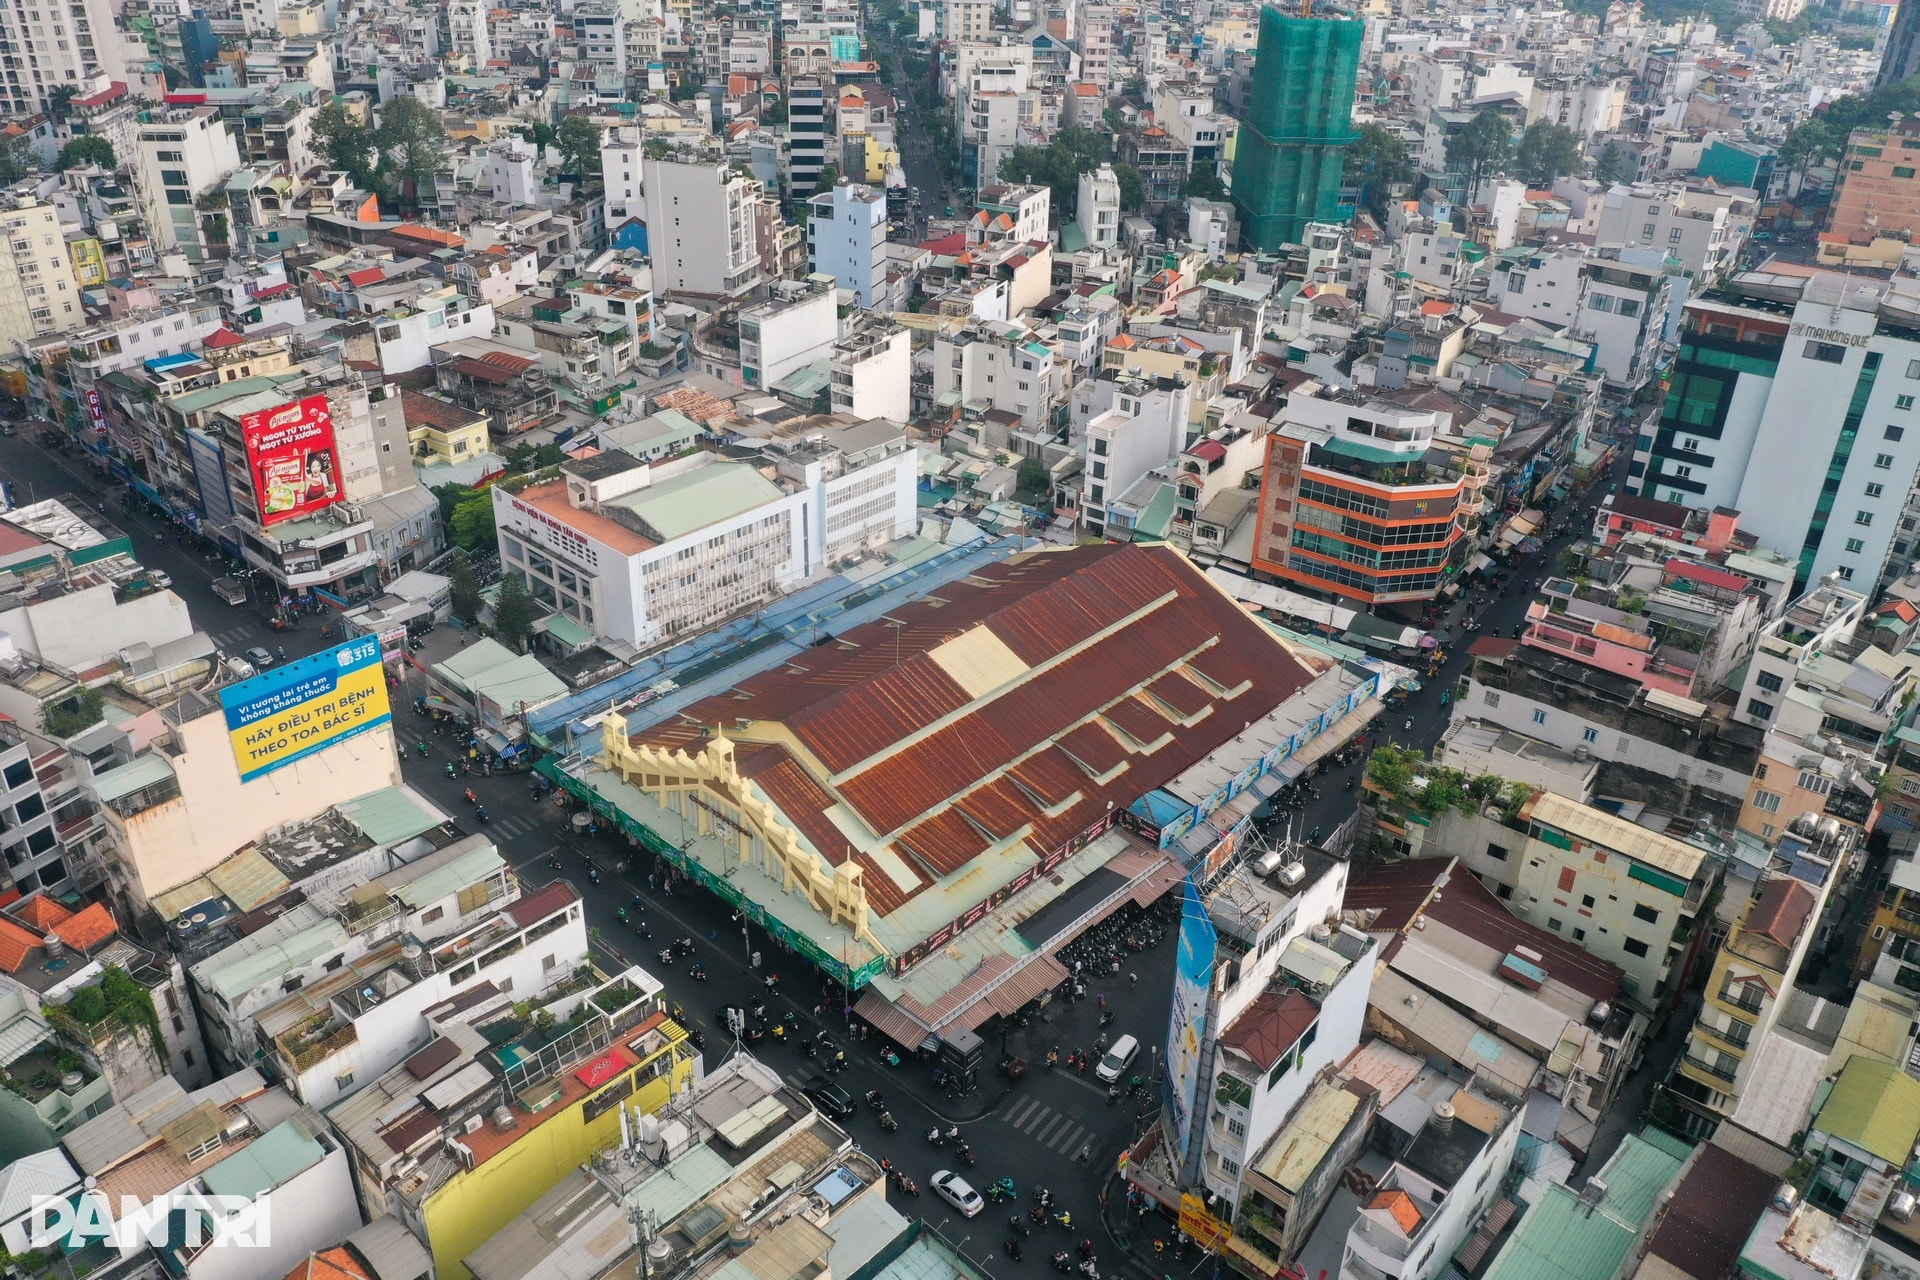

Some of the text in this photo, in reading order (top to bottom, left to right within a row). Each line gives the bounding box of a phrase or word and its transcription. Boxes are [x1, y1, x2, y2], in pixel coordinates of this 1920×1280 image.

[1805, 325, 1826, 339] MAI
[89, 394, 106, 430] GYM
[259, 439, 281, 451] NGỌT
[294, 428, 322, 441] XƯƠNG
[262, 430, 286, 442] NGON
[298, 422, 316, 432] THỊT
[353, 645, 376, 661] 315
[240, 683, 331, 723] không kháng thuốc
[251, 694, 281, 710] tương
[282, 688, 295, 698] lai
[296, 682, 310, 693] trẻ
[312, 676, 328, 686] em
[246, 686, 376, 746] HÃY ĐIỀU TRỊ BỆNH
[249, 738, 288, 760] THEO
[291, 725, 320, 743] TOA
[323, 712, 351, 730] BÁC
[353, 703, 366, 717] SĨ
